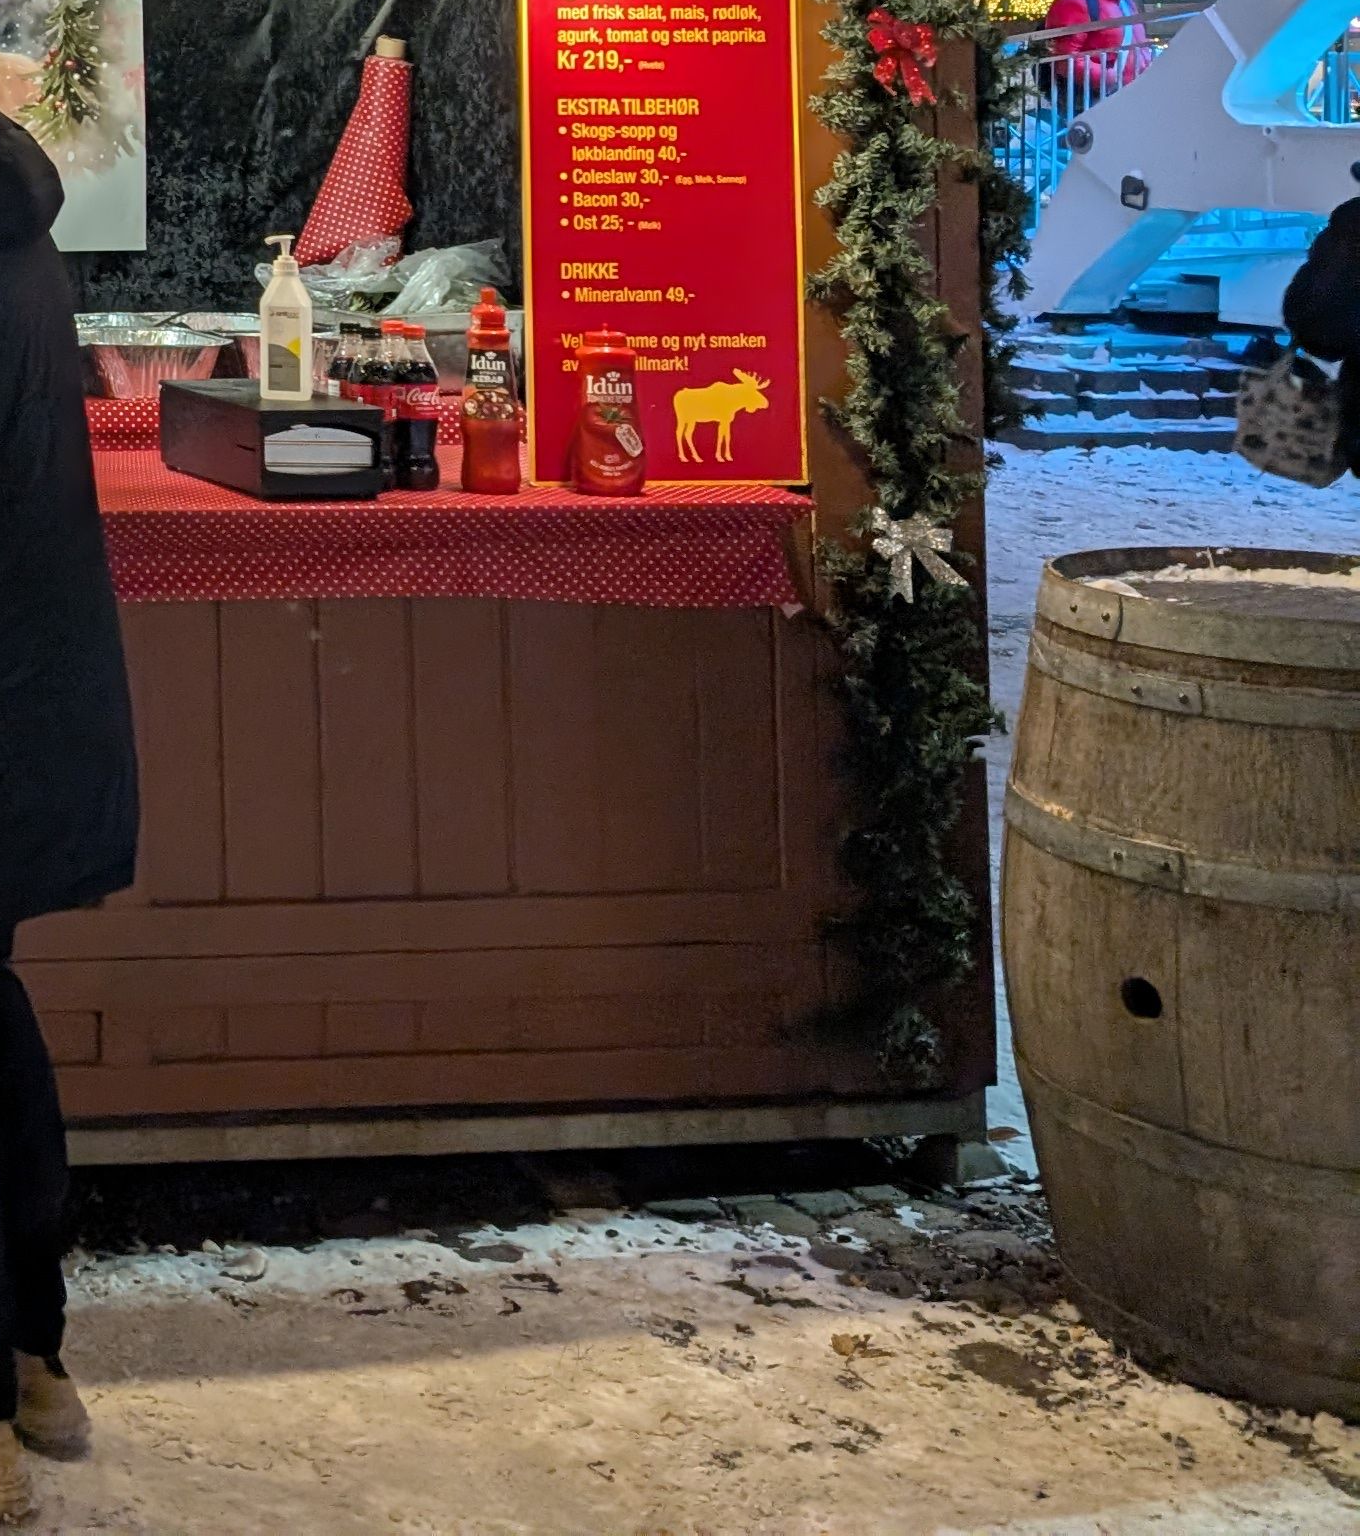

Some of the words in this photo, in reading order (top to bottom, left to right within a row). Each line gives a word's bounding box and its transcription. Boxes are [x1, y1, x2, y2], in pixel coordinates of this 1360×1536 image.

[557, 5, 589, 20] med
[592, 4, 625, 19] frisk
[628, 5, 667, 22] salat,
[670, 5, 709, 22] mais,
[713, 4, 761, 22] rødløk,
[557, 29, 603, 46] agurk,
[606, 29, 648, 43] tomat
[652, 31, 670, 45] og
[673, 28, 709, 42] stekt
[713, 27, 765, 45] paprika
[557, 50, 577, 69] Kr
[583, 50, 632, 72] 219,-
[557, 100, 620, 116] EKSTRA
[621, 98, 699, 115] TILBEHØR
[572, 123, 656, 140] Skogs-sopp
[659, 126, 677, 141] og
[572, 146, 654, 164] løkblanding
[658, 146, 687, 164] 40,-
[572, 169, 636, 184] Coleslaw
[640, 169, 669, 186] 30,-
[573, 192, 617, 207] Bacon
[621, 192, 650, 209] 30,-
[573, 215, 597, 231] Ost
[561, 263, 619, 280] DRIKKE
[575, 287, 662, 303] Mineralvann
[666, 287, 695, 304] 49,-
[662, 336, 679, 350] og
[684, 334, 706, 350] nyt
[710, 334, 766, 349] smaken
[470, 353, 507, 371] Idun
[562, 359, 578, 371] av
[635, 356, 689, 372] illmark!
[586, 375, 633, 395] Idun
